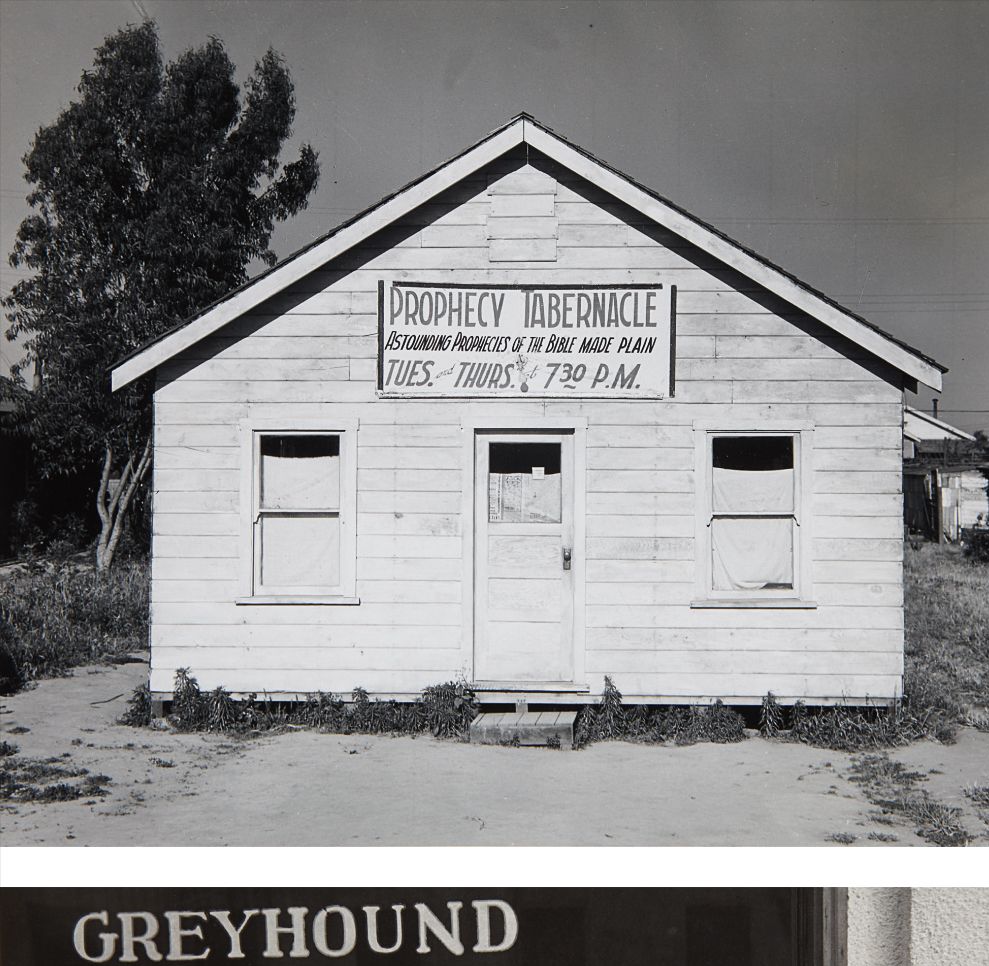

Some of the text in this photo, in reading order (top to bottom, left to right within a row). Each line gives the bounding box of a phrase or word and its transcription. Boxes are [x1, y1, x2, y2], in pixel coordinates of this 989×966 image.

[389, 286, 657, 329] PROPHECY TABERNACLE
[385, 331, 657, 354] ASTOUNDING PROPHECIES OF THE BIBLE MADE PLAIN
[385, 360, 435, 387] TUES.
[454, 361, 515, 388] THURS.
[591, 363, 641, 390] P.M.
[73, 899, 519, 963] GREYHOUND
